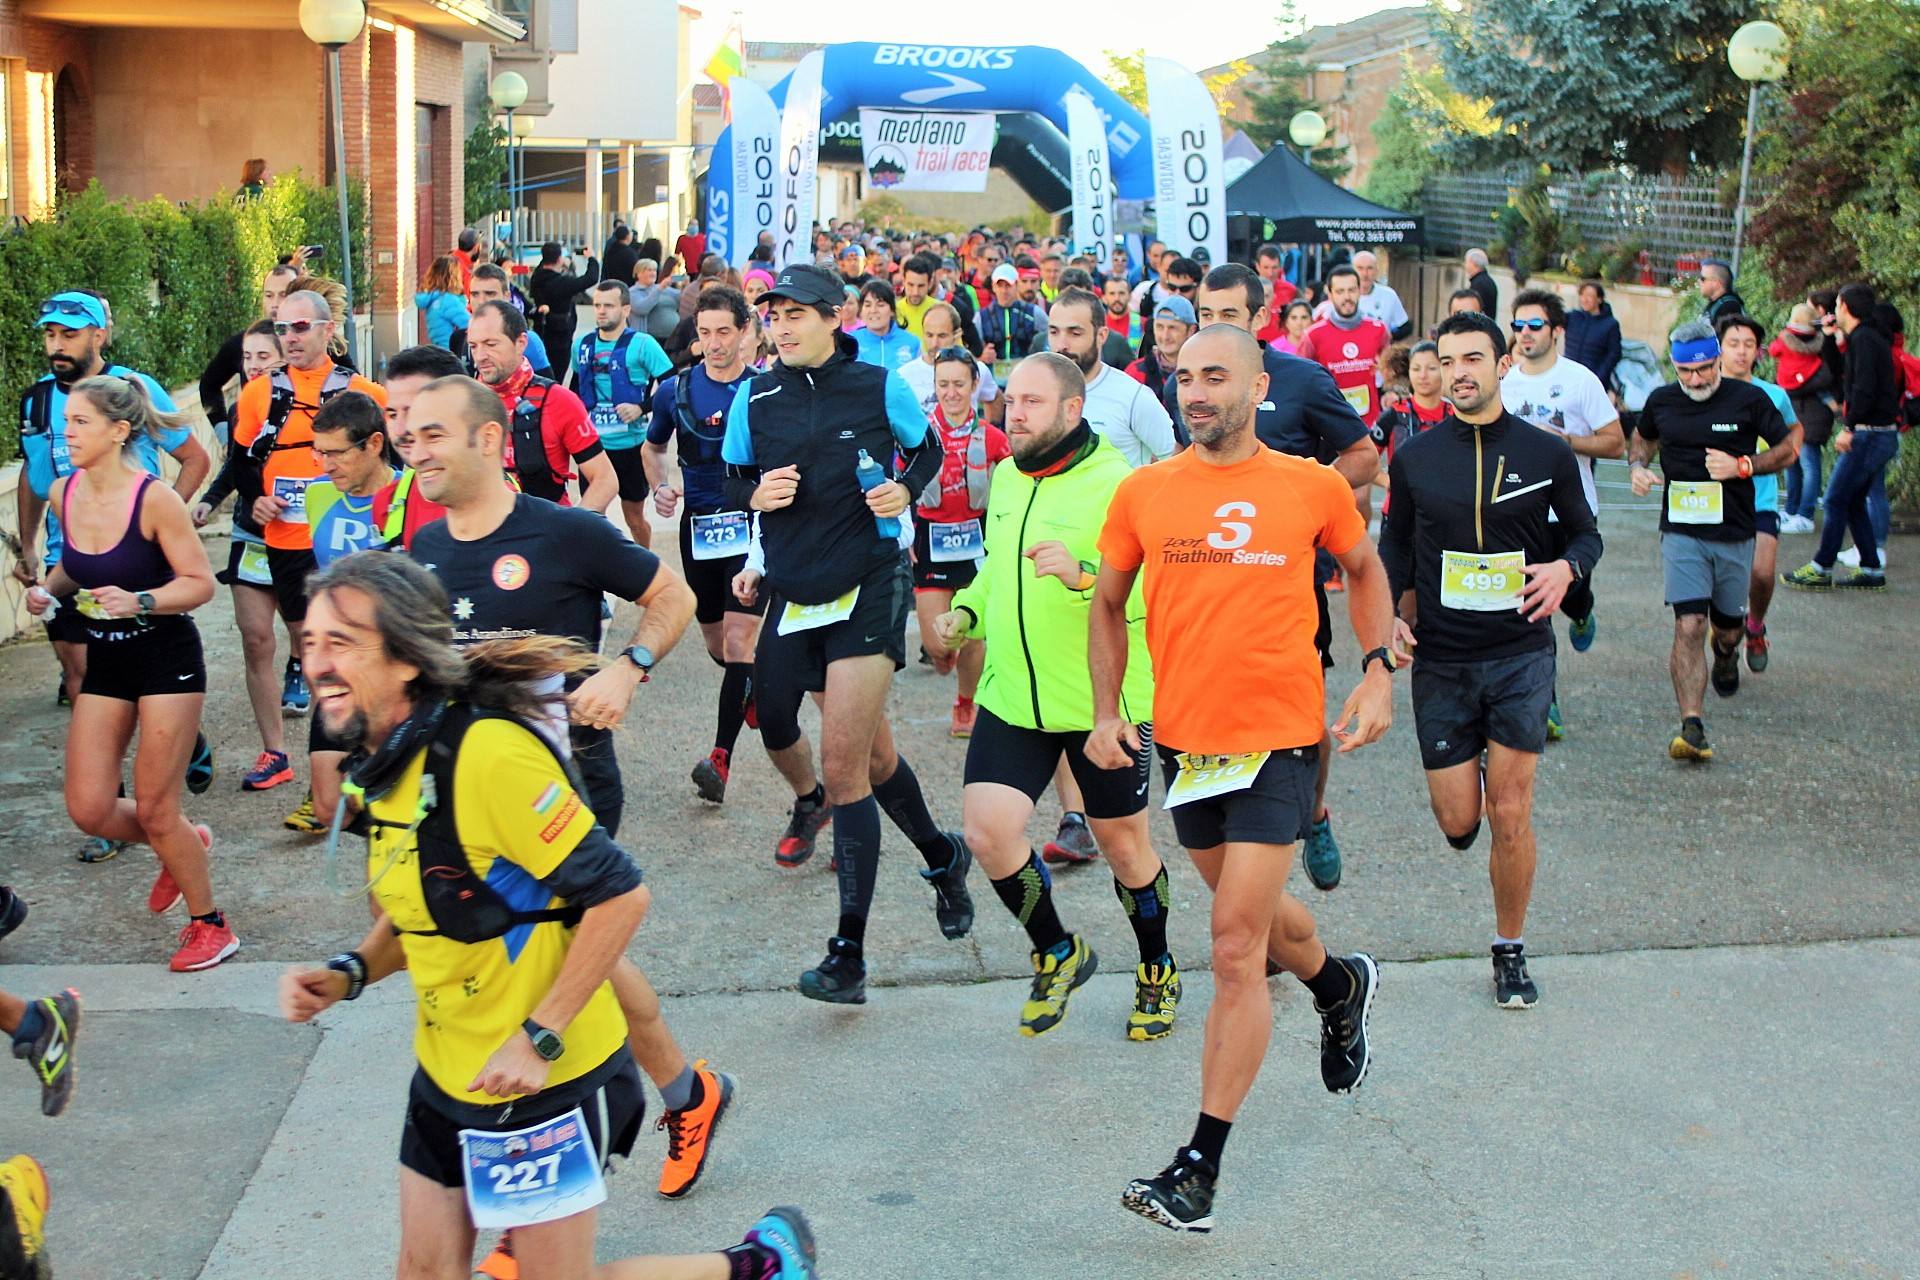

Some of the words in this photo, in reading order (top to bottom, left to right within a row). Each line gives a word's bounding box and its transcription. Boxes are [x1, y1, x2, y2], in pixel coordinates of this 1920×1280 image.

[873, 44, 1017, 70] BROOKS
[915, 146, 950, 172] trail
[953, 150, 988, 172] race
[1315, 219, 1417, 231] www.podoactiva.com
[1328, 230, 1346, 242] Tel.
[595, 413, 618, 425] 212
[704, 526, 737, 544] 273
[942, 532, 971, 549] 207
[1461, 572, 1507, 592] 499
[488, 1152, 562, 1195] 227
